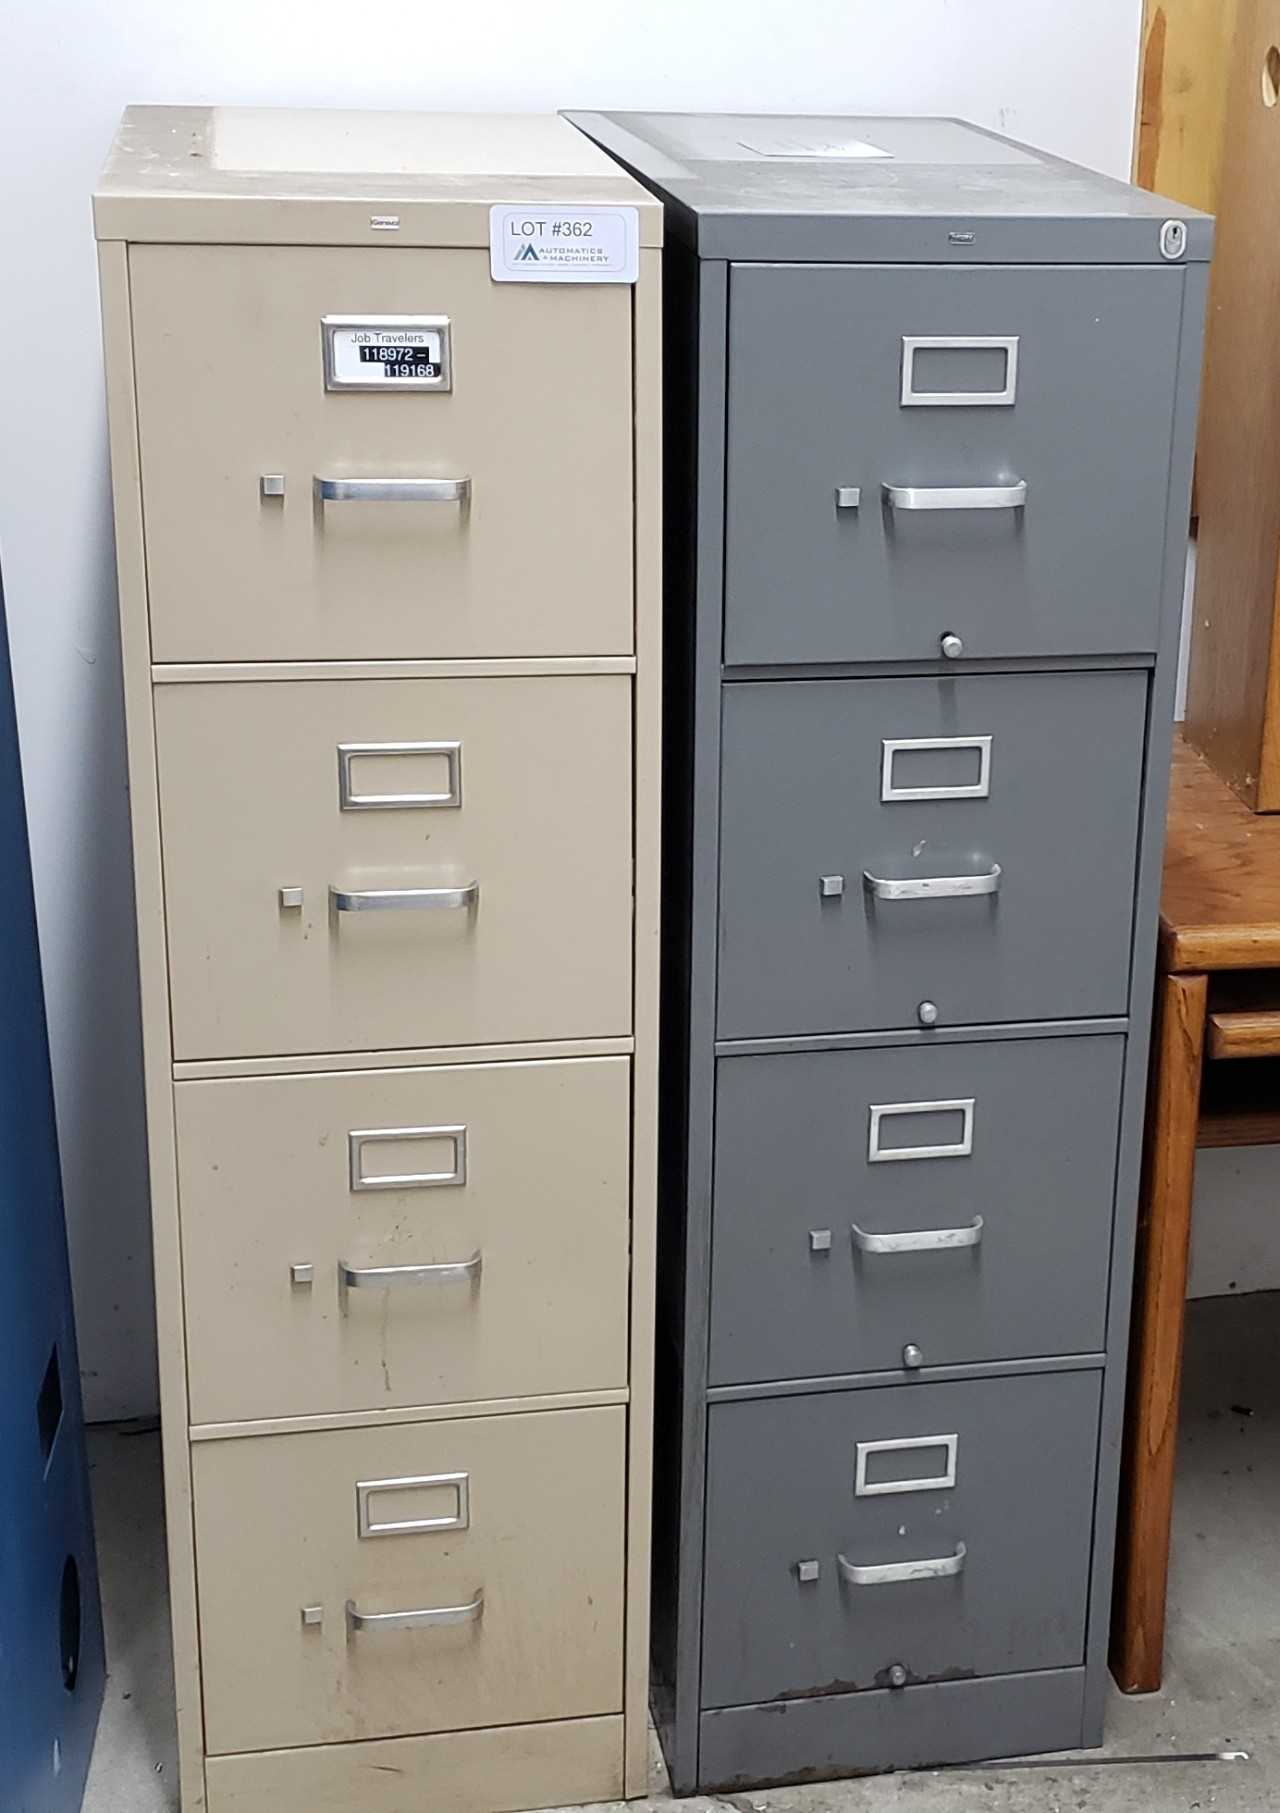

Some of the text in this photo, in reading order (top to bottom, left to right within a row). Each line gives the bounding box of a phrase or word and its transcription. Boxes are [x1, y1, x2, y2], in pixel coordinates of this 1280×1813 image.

[511, 221, 593, 237] LOT #362
[539, 247, 603, 255] AUTOMATICS
[351, 333, 424, 343] Job Travelers
[385, 364, 434, 377] 119168
